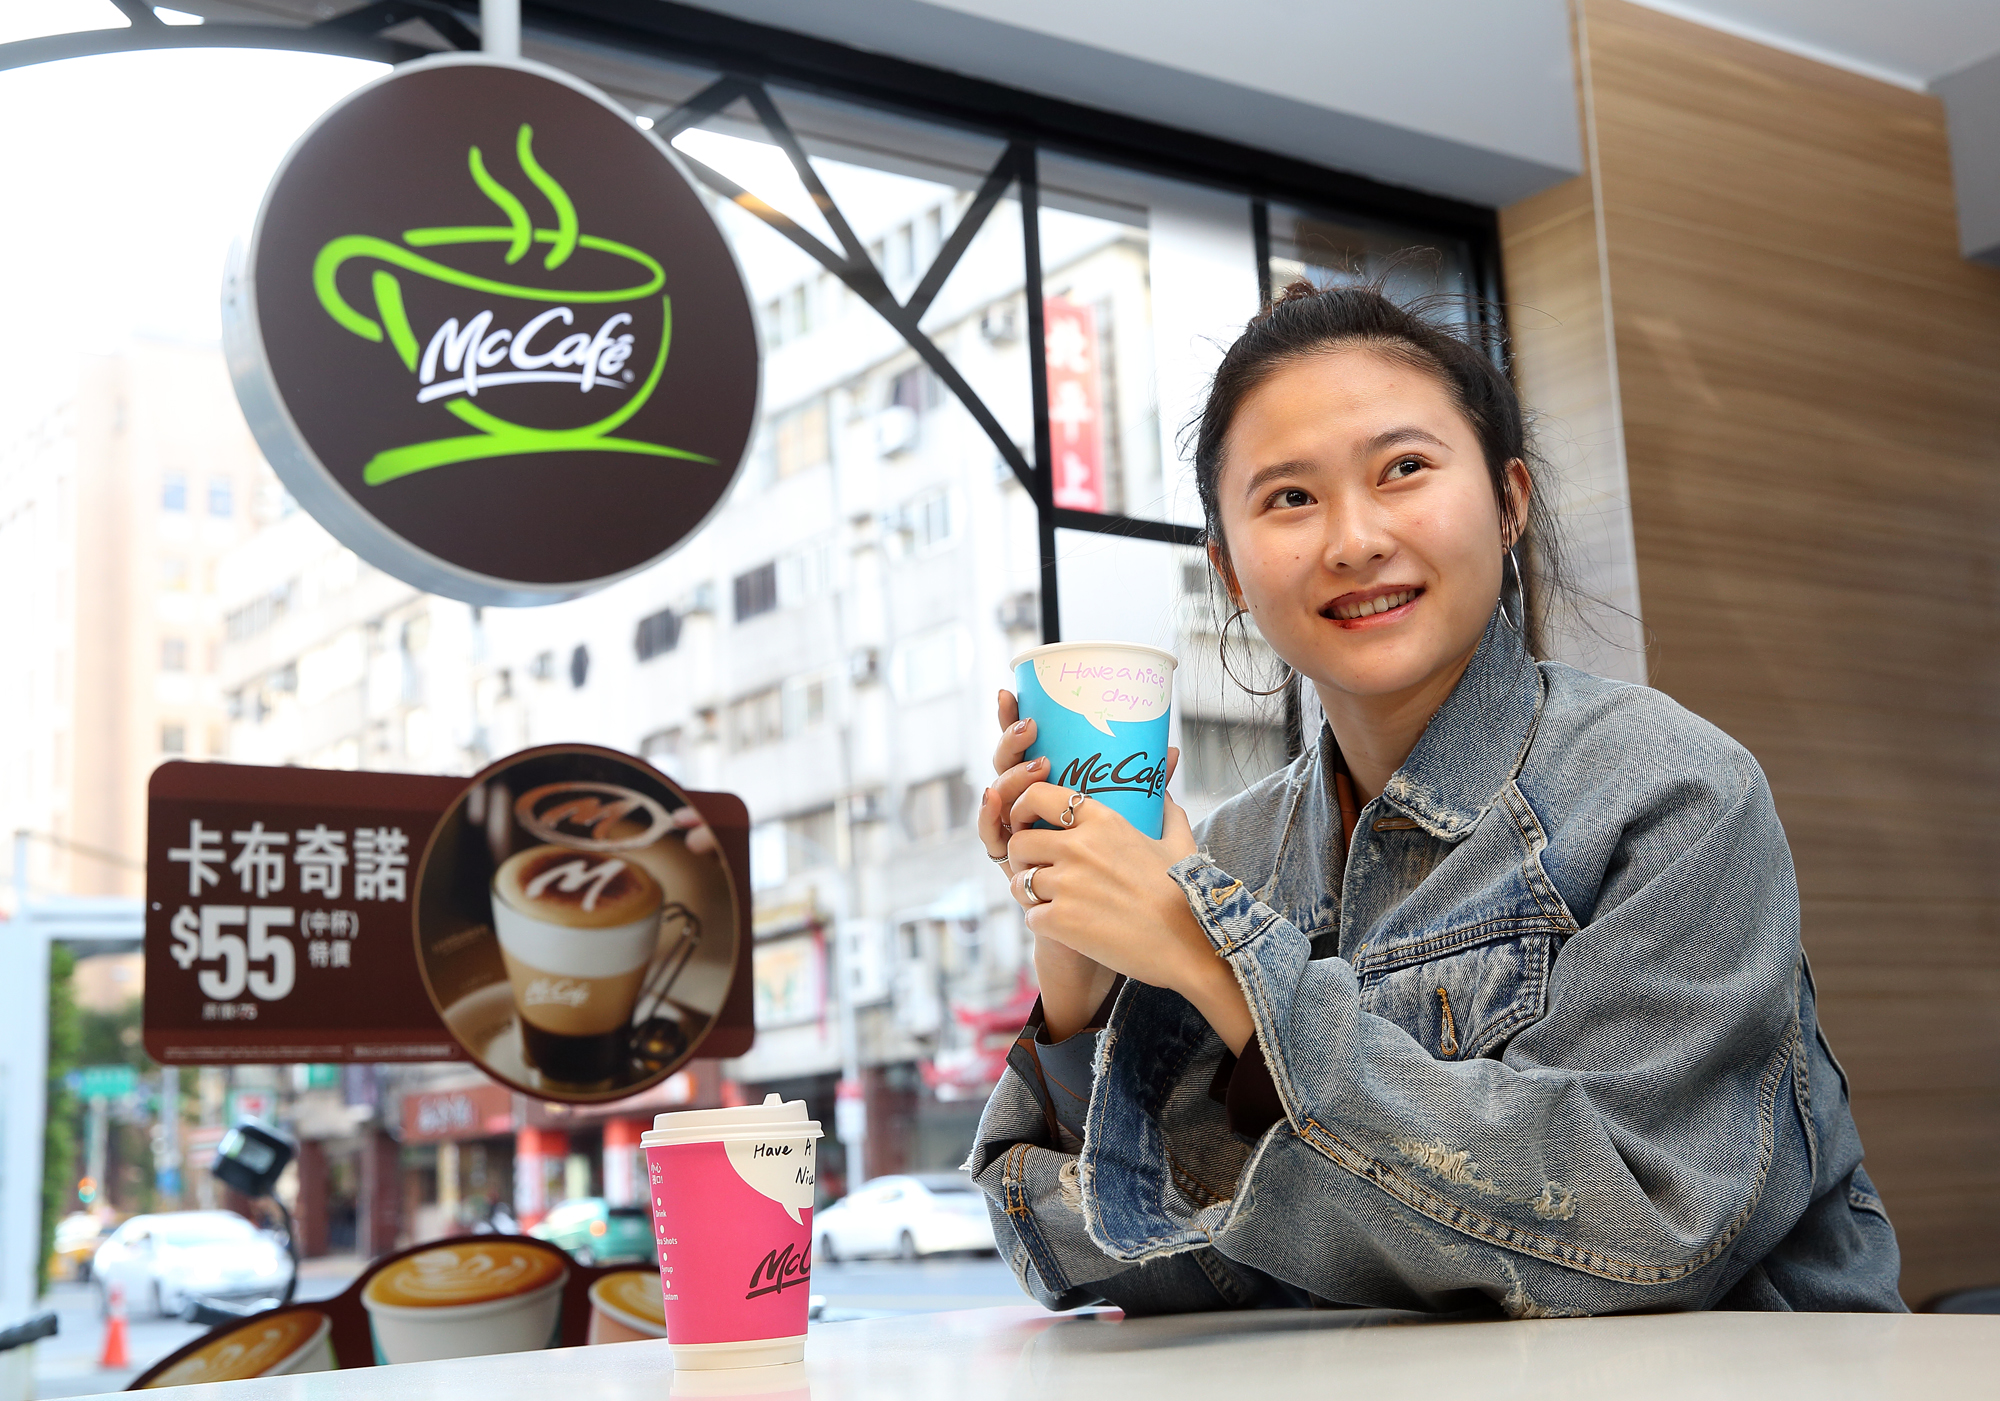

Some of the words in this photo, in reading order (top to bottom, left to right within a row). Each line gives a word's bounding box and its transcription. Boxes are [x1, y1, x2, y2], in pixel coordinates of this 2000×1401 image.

[418, 305, 635, 398] McCafé
[1060, 662, 1113, 682] Have
[1117, 667, 1131, 681] a
[1136, 668, 1165, 688] nice
[1057, 752, 1166, 799] McCafé
[167, 818, 409, 902] 卡布奇諾
[300, 907, 360, 939] (中杯)
[169, 904, 296, 1001] $55
[308, 939, 352, 968] 特價
[753, 1142, 793, 1159] Have
[804, 1137, 812, 1156] A
[655, 1210, 667, 1218] Drink
[663, 1237, 678, 1245] Shots
[661, 1265, 674, 1275] Syrup
[663, 1293, 679, 1301] Custom
